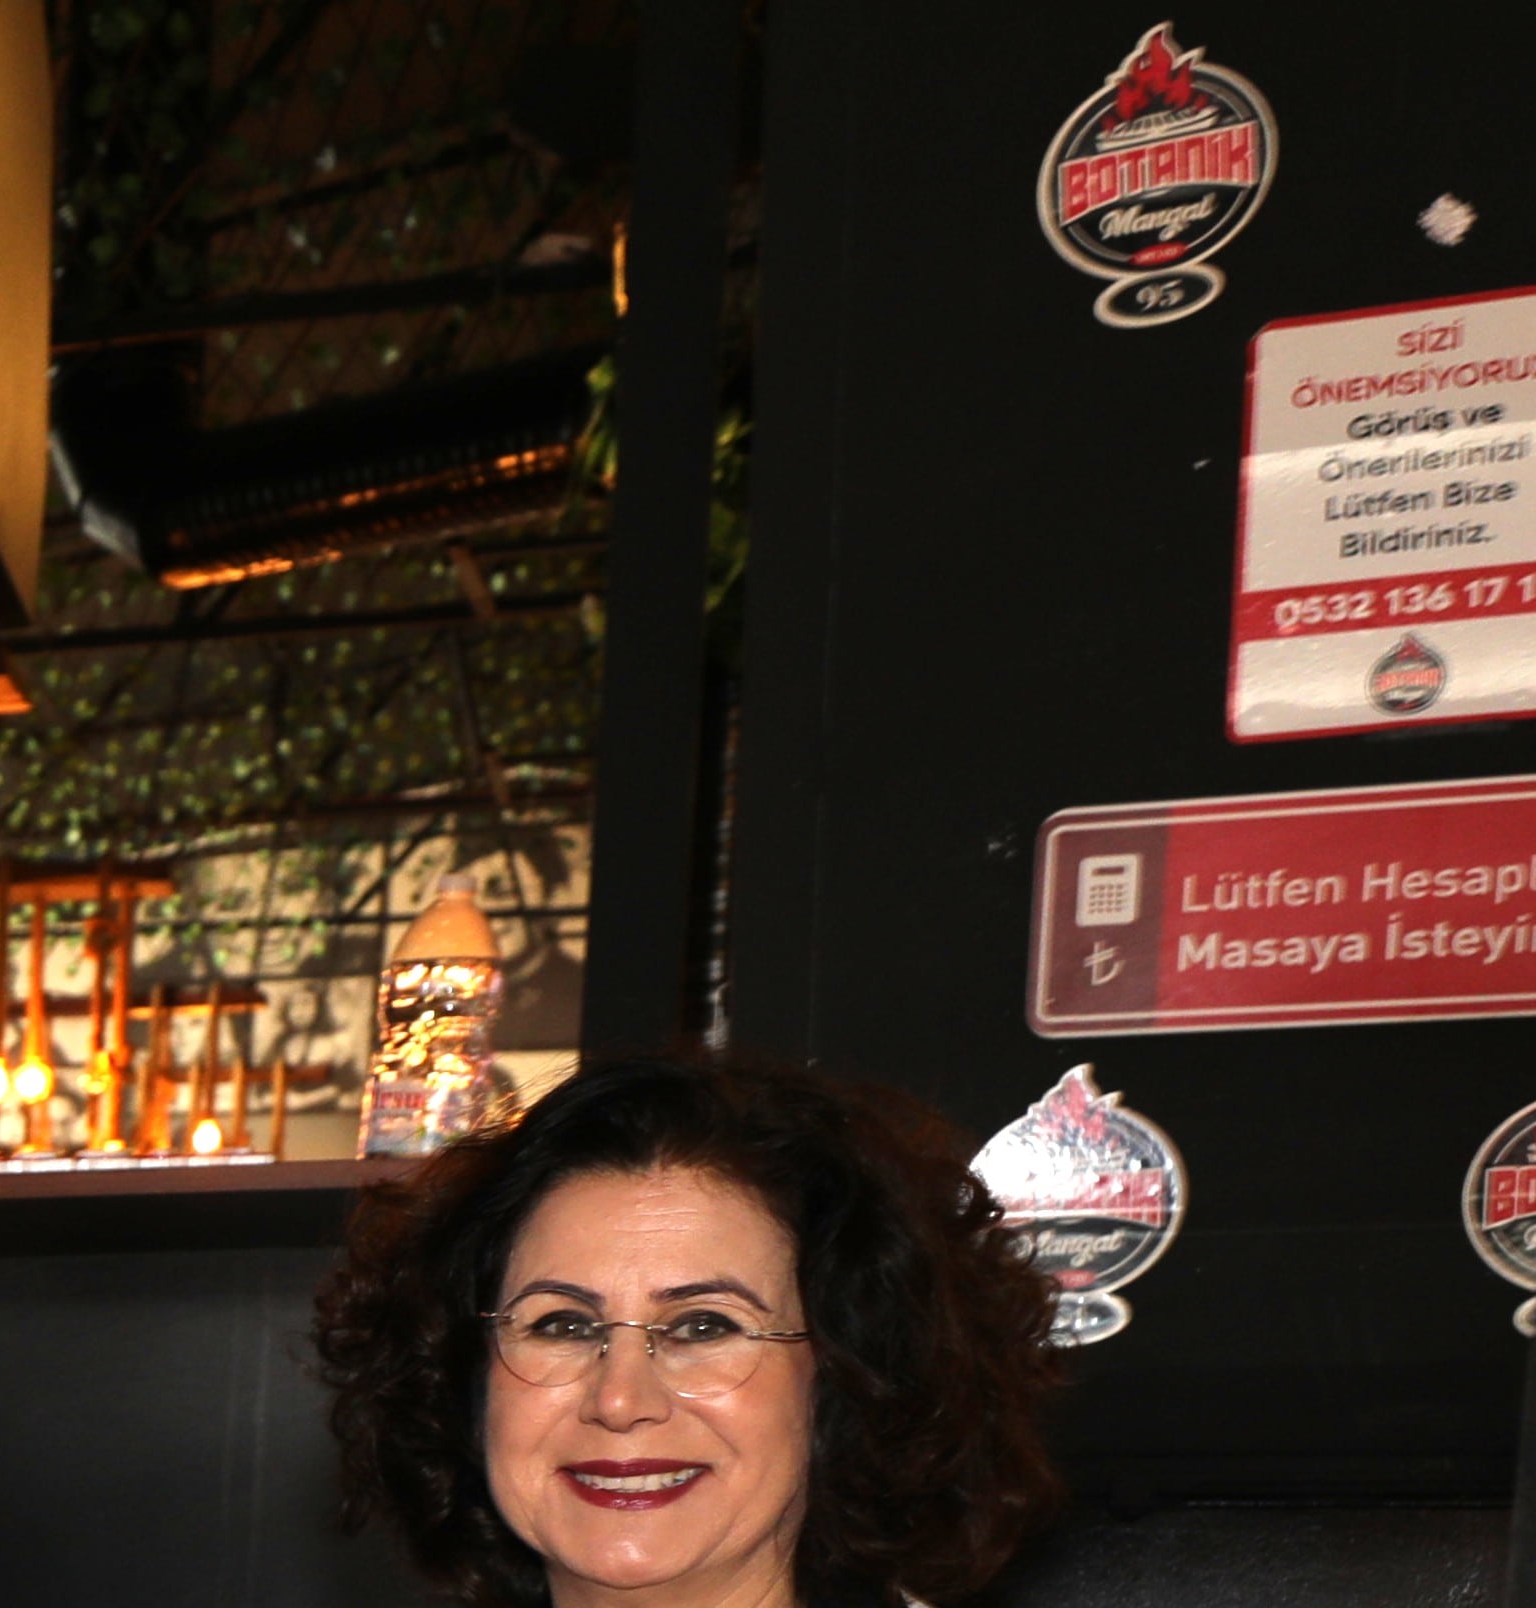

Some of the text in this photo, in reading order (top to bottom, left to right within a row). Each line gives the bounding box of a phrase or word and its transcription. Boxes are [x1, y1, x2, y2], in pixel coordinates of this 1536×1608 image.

[1099, 193, 1216, 241] Mangal
[1396, 317, 1466, 357] SİZİ
[1347, 403, 1506, 440] Görüş ve
[1318, 434, 1530, 483] Önerilerinizi
[1324, 480, 1518, 522] Lütfen Bize
[1273, 590, 1376, 629] 0532
[1383, 581, 1457, 616] 136
[1463, 576, 1509, 607] 17
[1181, 868, 1347, 913] Lütfen
[1177, 931, 1370, 974] Masaya
